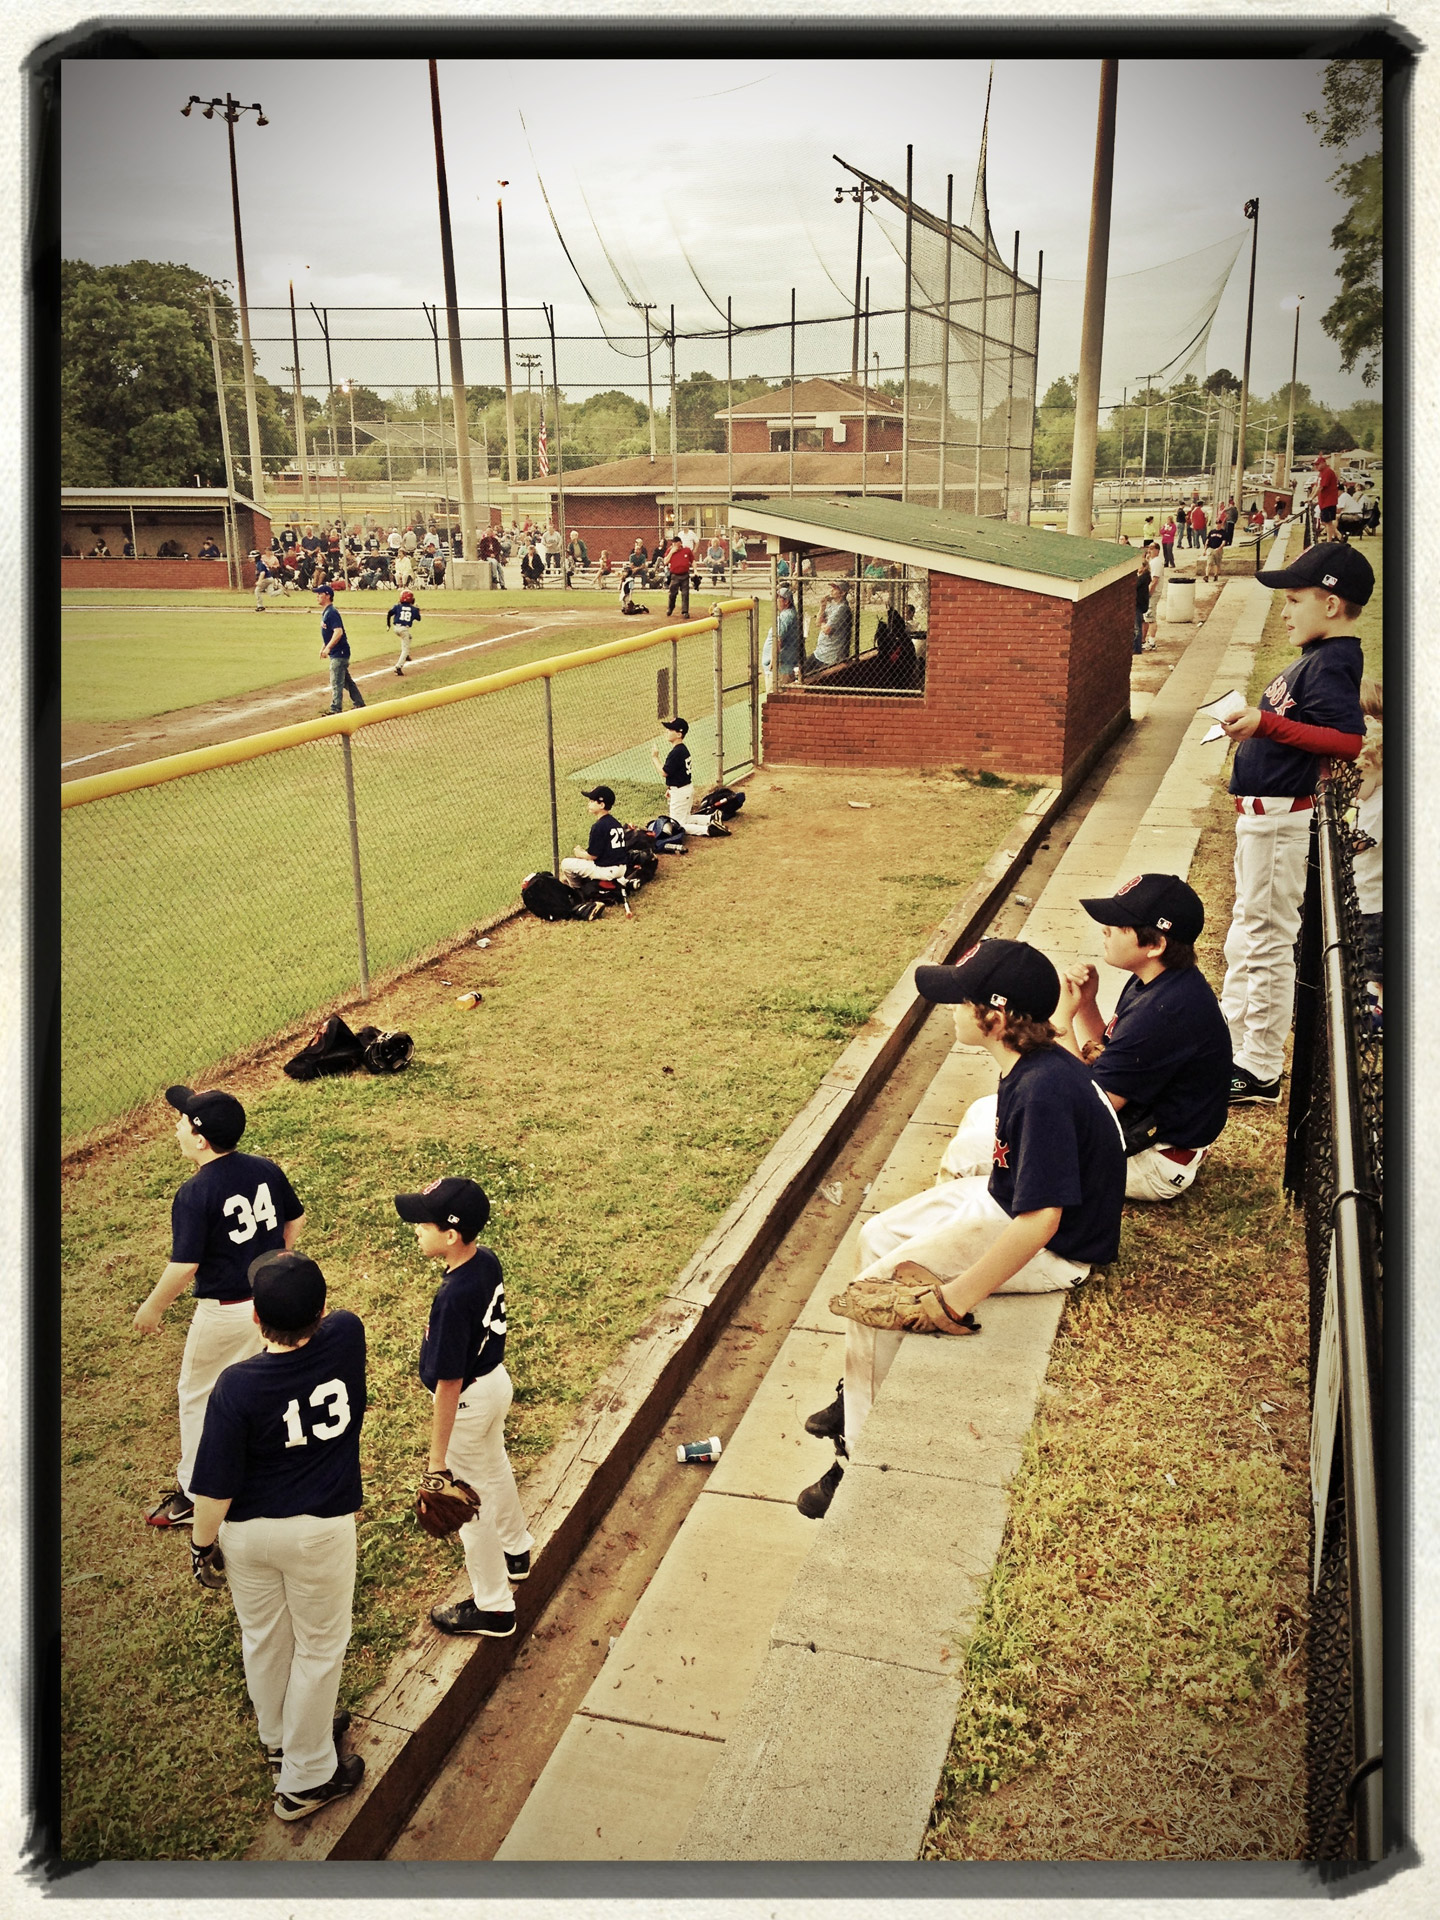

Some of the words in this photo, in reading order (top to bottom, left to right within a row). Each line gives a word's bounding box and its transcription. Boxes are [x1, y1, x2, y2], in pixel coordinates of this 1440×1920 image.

[399, 610, 412, 622] 18
[1263, 675, 1297, 717] SOX
[223, 1182, 278, 1245] 34
[282, 1378, 352, 1449] 13
